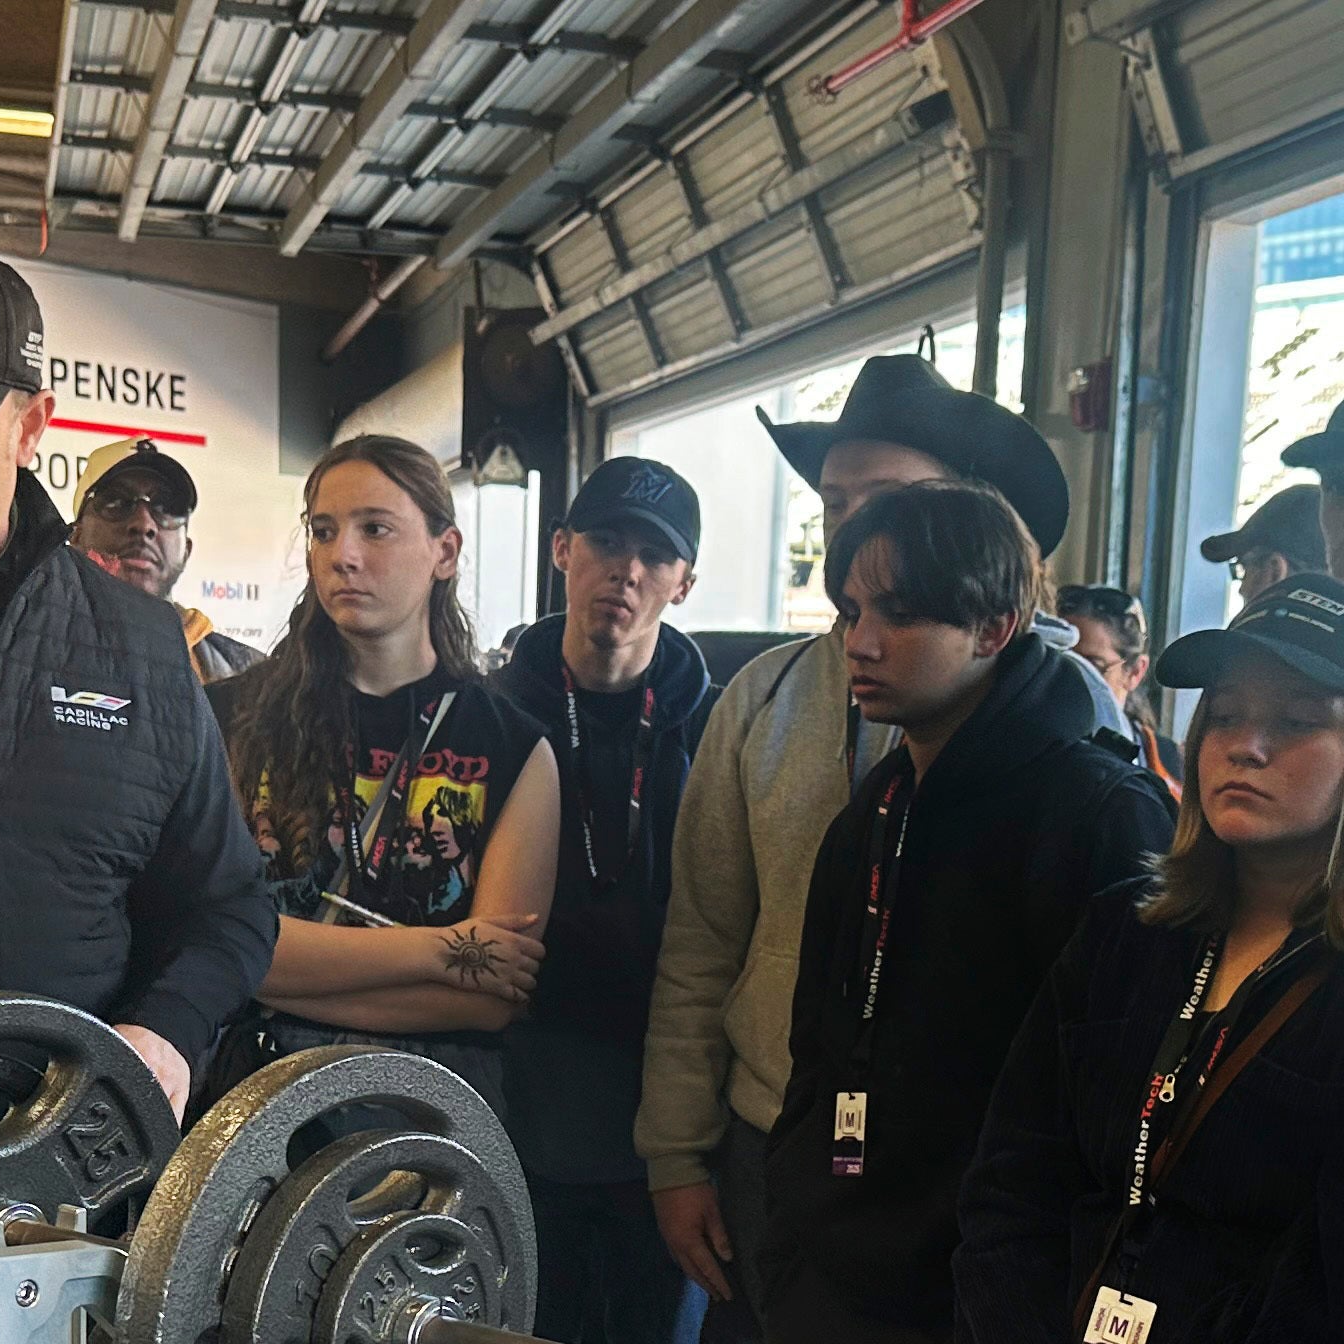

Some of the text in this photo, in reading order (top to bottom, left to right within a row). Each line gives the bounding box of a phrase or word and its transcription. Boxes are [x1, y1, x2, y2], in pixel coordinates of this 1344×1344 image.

[50, 357, 186, 412] PENSKE
[201, 581, 244, 600] Mobil
[1296, 590, 1344, 614] STEM
[53, 705, 129, 726] CADILLAC
[55, 713, 112, 731] RACING
[369, 747, 490, 781] FOYD
[58, 1102, 130, 1181] 25
[1129, 1071, 1165, 1206] WeatherTech
[359, 1263, 398, 1323] 2.5
[1109, 1315, 1130, 1338] M
